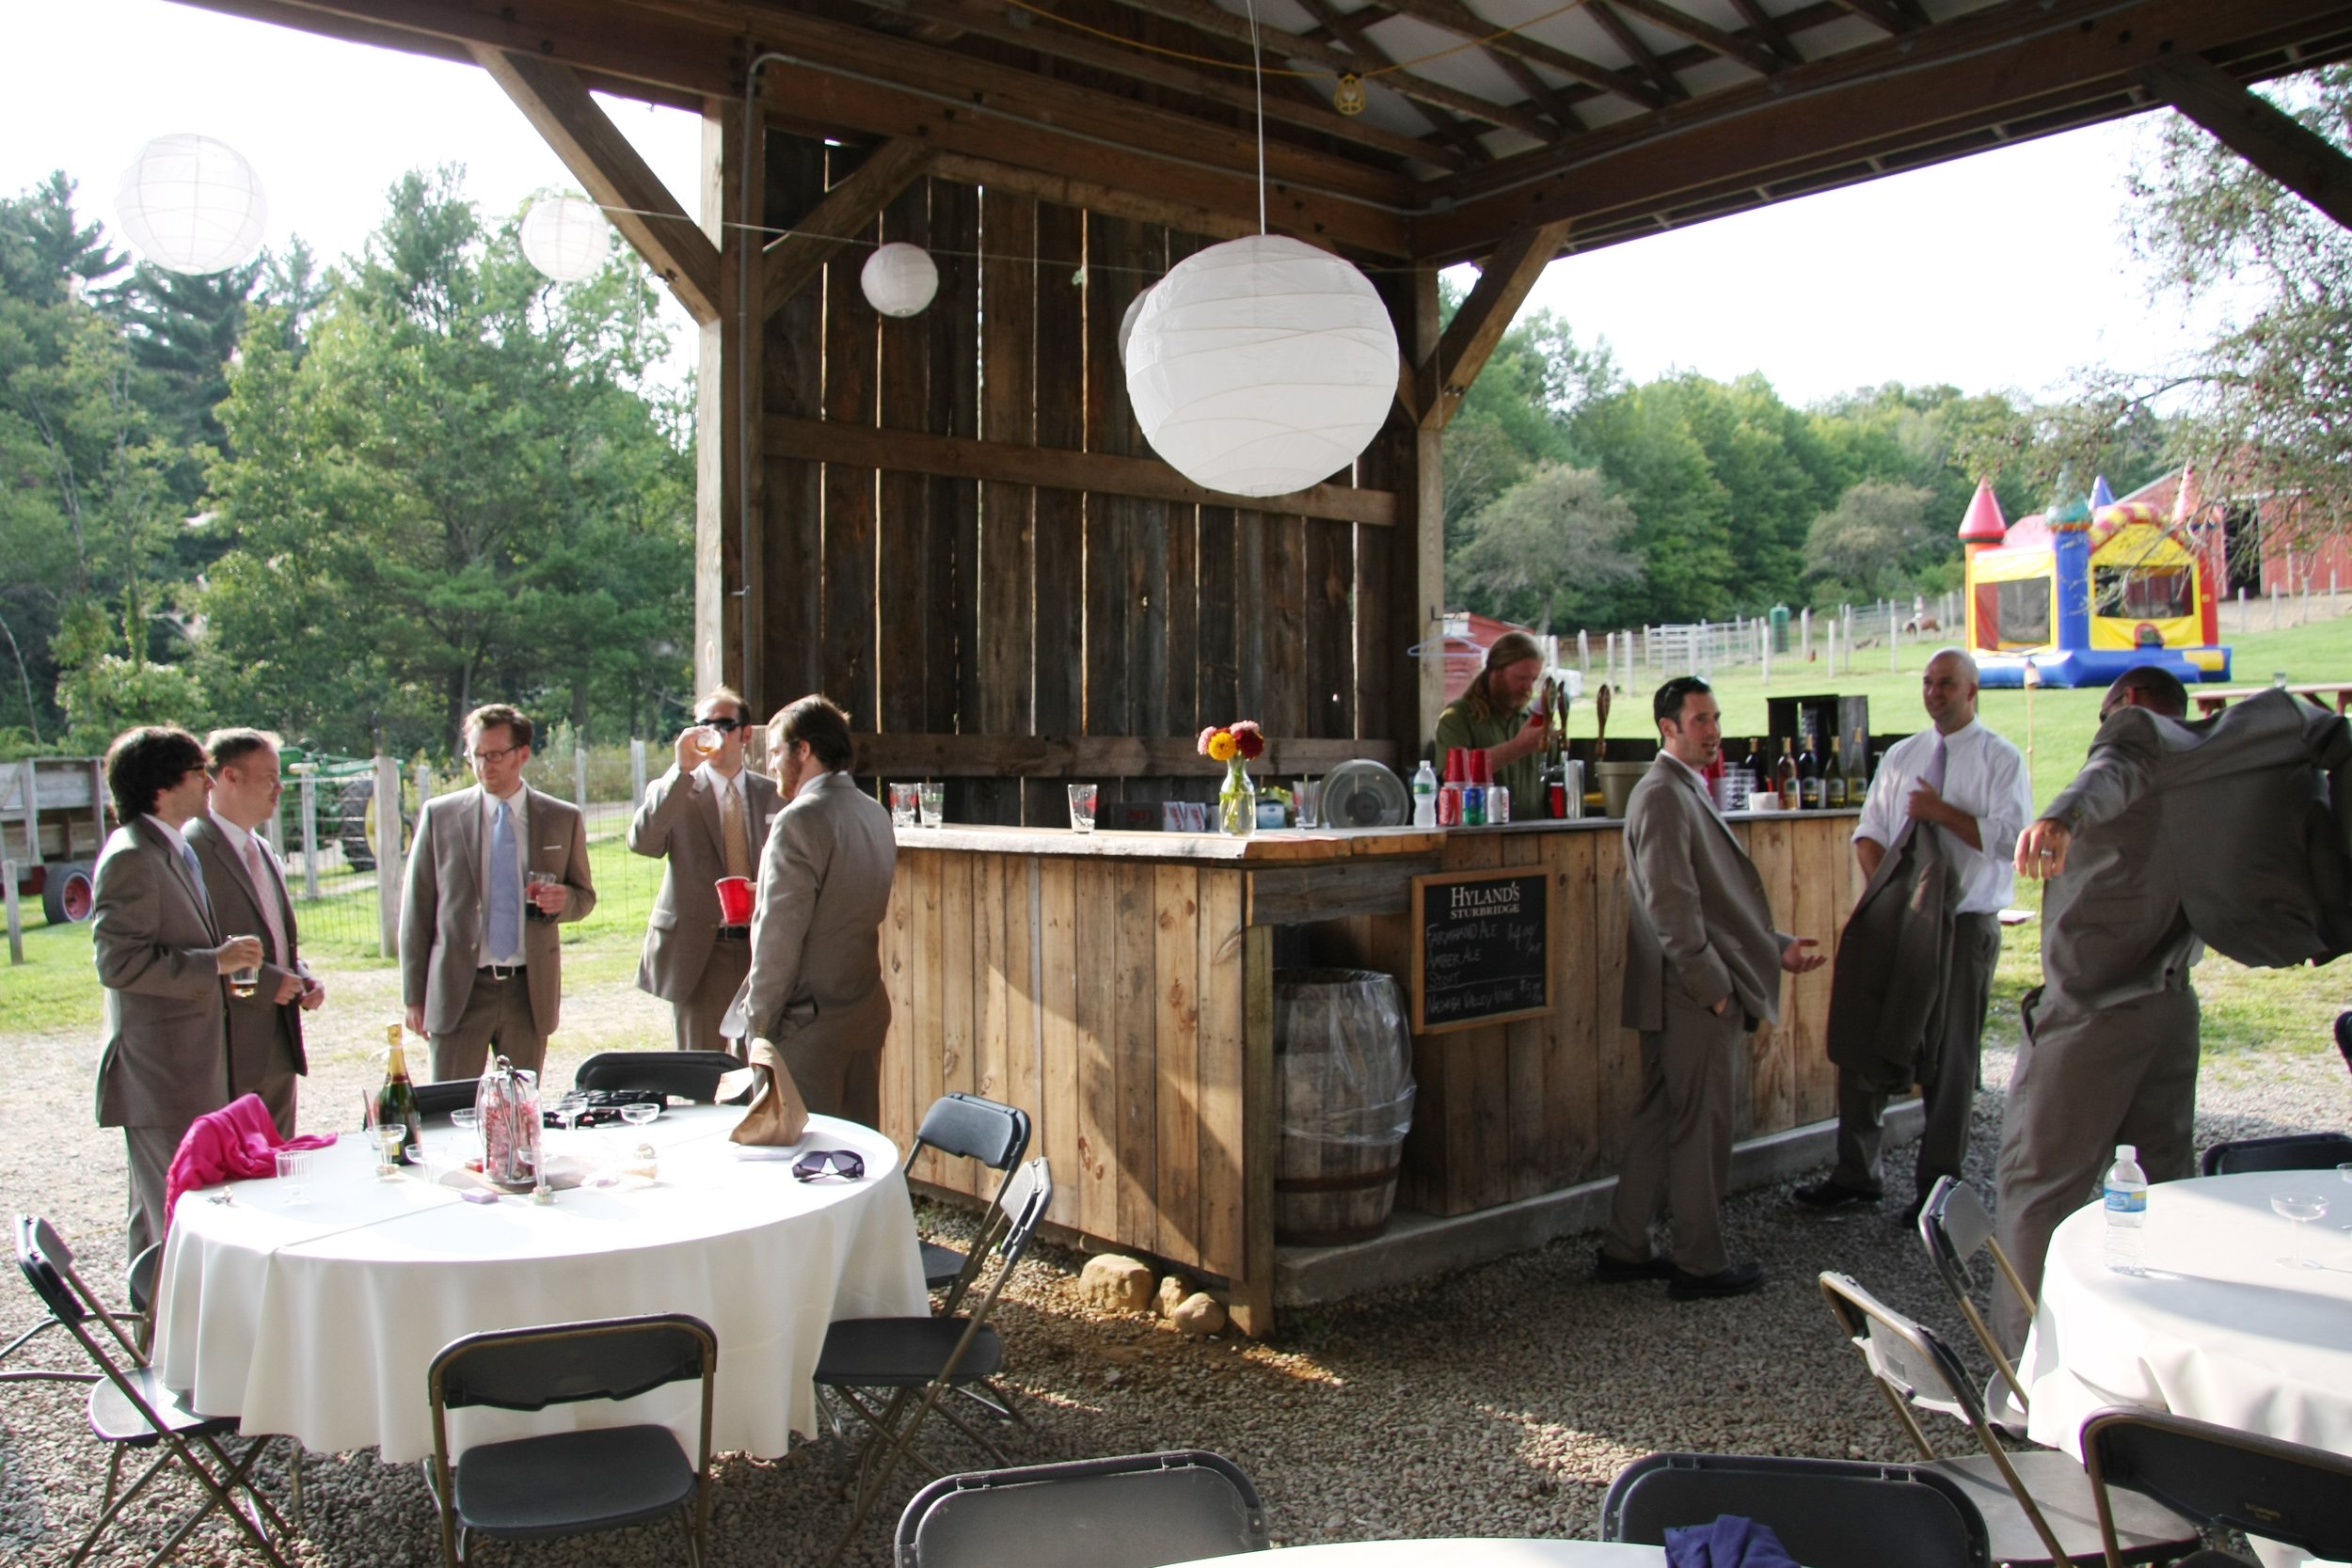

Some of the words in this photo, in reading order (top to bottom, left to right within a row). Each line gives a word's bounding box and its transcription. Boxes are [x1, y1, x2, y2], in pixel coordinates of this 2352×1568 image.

[1452, 881, 1520, 908] HYLAND'S
[1451, 903, 1520, 919] STURBRIDGE
[1479, 919, 1499, 941] ALE
[1426, 947, 1463, 971] AMBER
[1462, 943, 1483, 963] ALE
[1429, 972, 1460, 988] STOUT
